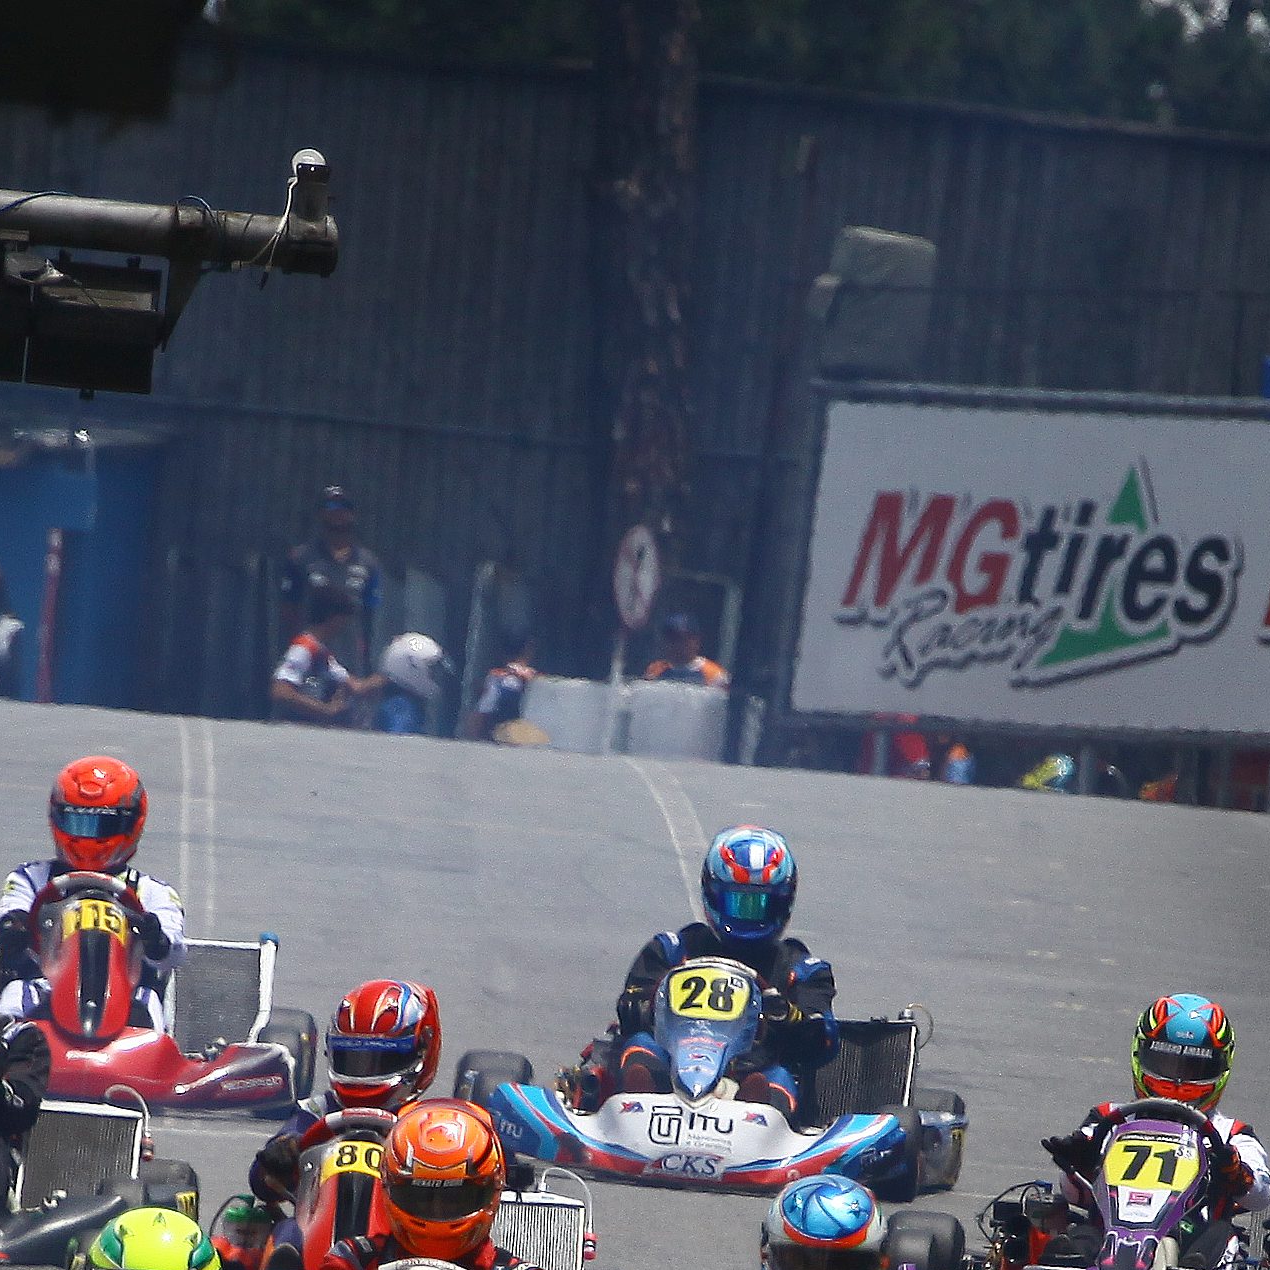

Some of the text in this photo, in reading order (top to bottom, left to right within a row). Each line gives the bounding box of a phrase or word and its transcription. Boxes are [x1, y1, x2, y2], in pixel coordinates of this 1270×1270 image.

[840, 488, 1232, 625] MGtires
[883, 588, 1070, 686] Racing
[679, 976, 735, 1013] 28
[662, 1153, 715, 1175] CKS
[1121, 1144, 1178, 1186] 71
